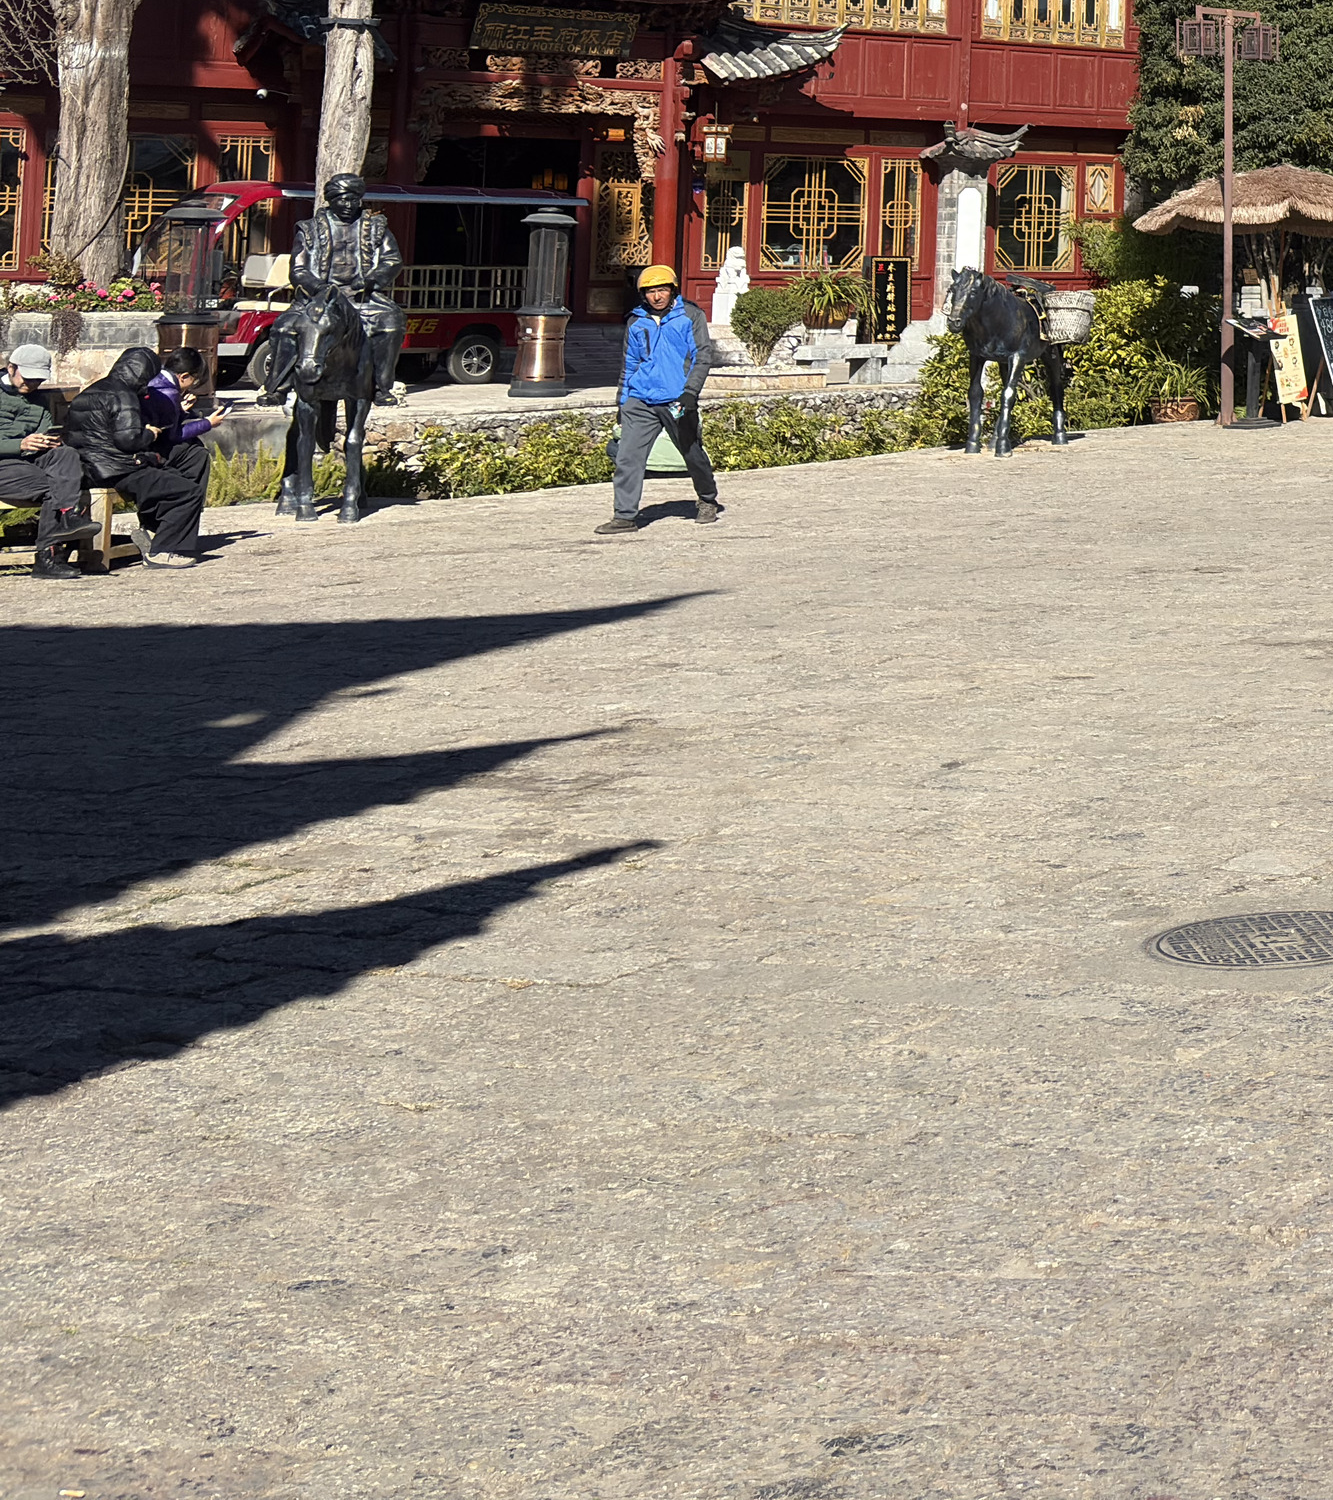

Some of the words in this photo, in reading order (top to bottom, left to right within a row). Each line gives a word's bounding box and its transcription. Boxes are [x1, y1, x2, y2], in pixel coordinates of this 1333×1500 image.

[482, 22, 626, 46] 丽江王府饭店
[481, 38, 513, 50] WANG
[515, 40, 530, 50] FU
[533, 41, 566, 52] HOTEL
